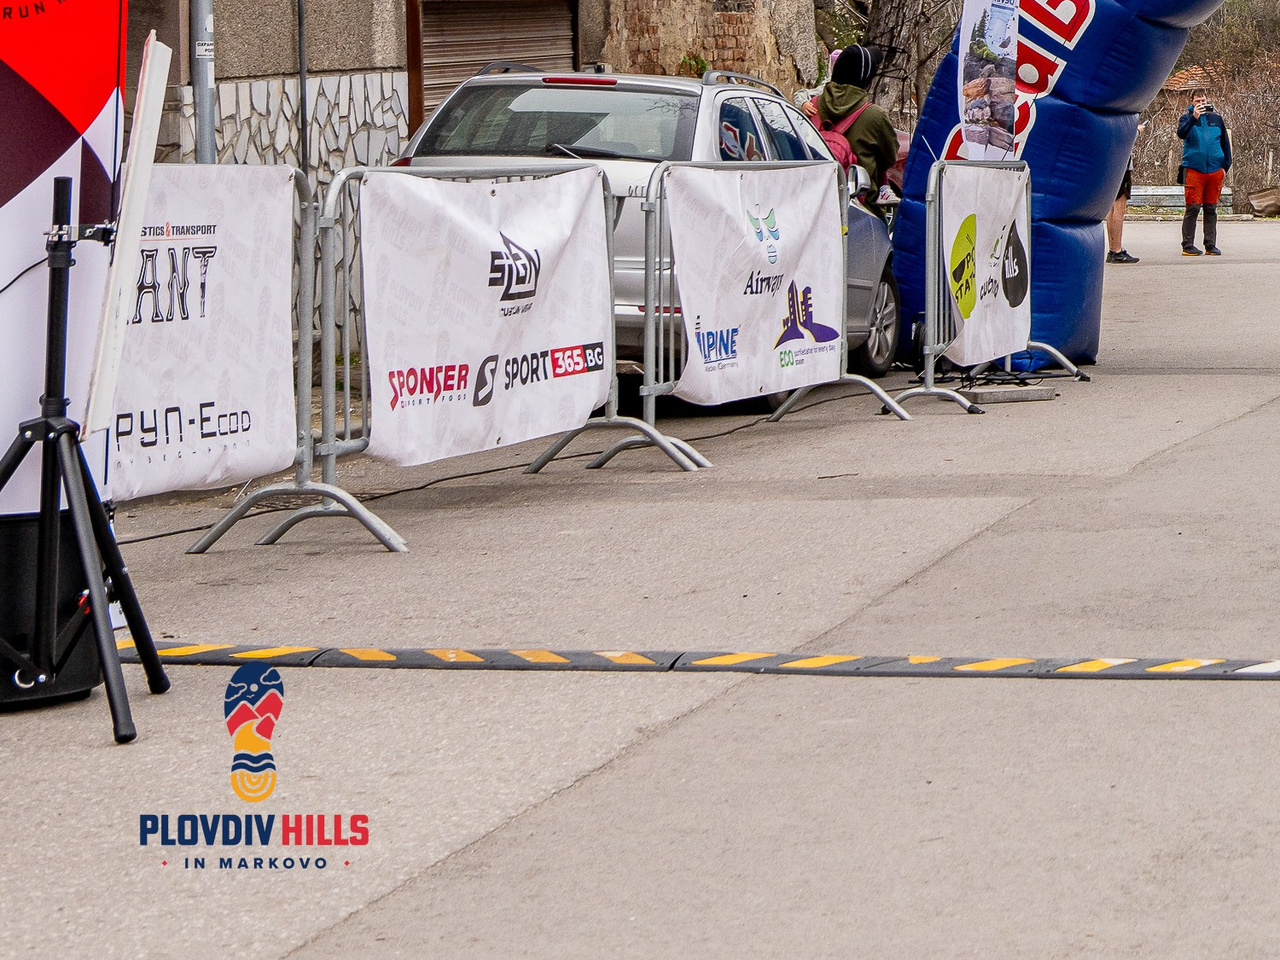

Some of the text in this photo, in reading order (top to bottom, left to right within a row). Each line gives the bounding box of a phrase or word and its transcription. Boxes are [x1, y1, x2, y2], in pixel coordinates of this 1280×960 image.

[2, 1, 46, 19] RUN
[127, 246, 217, 325] ANT
[388, 364, 470, 411] SPONSER
